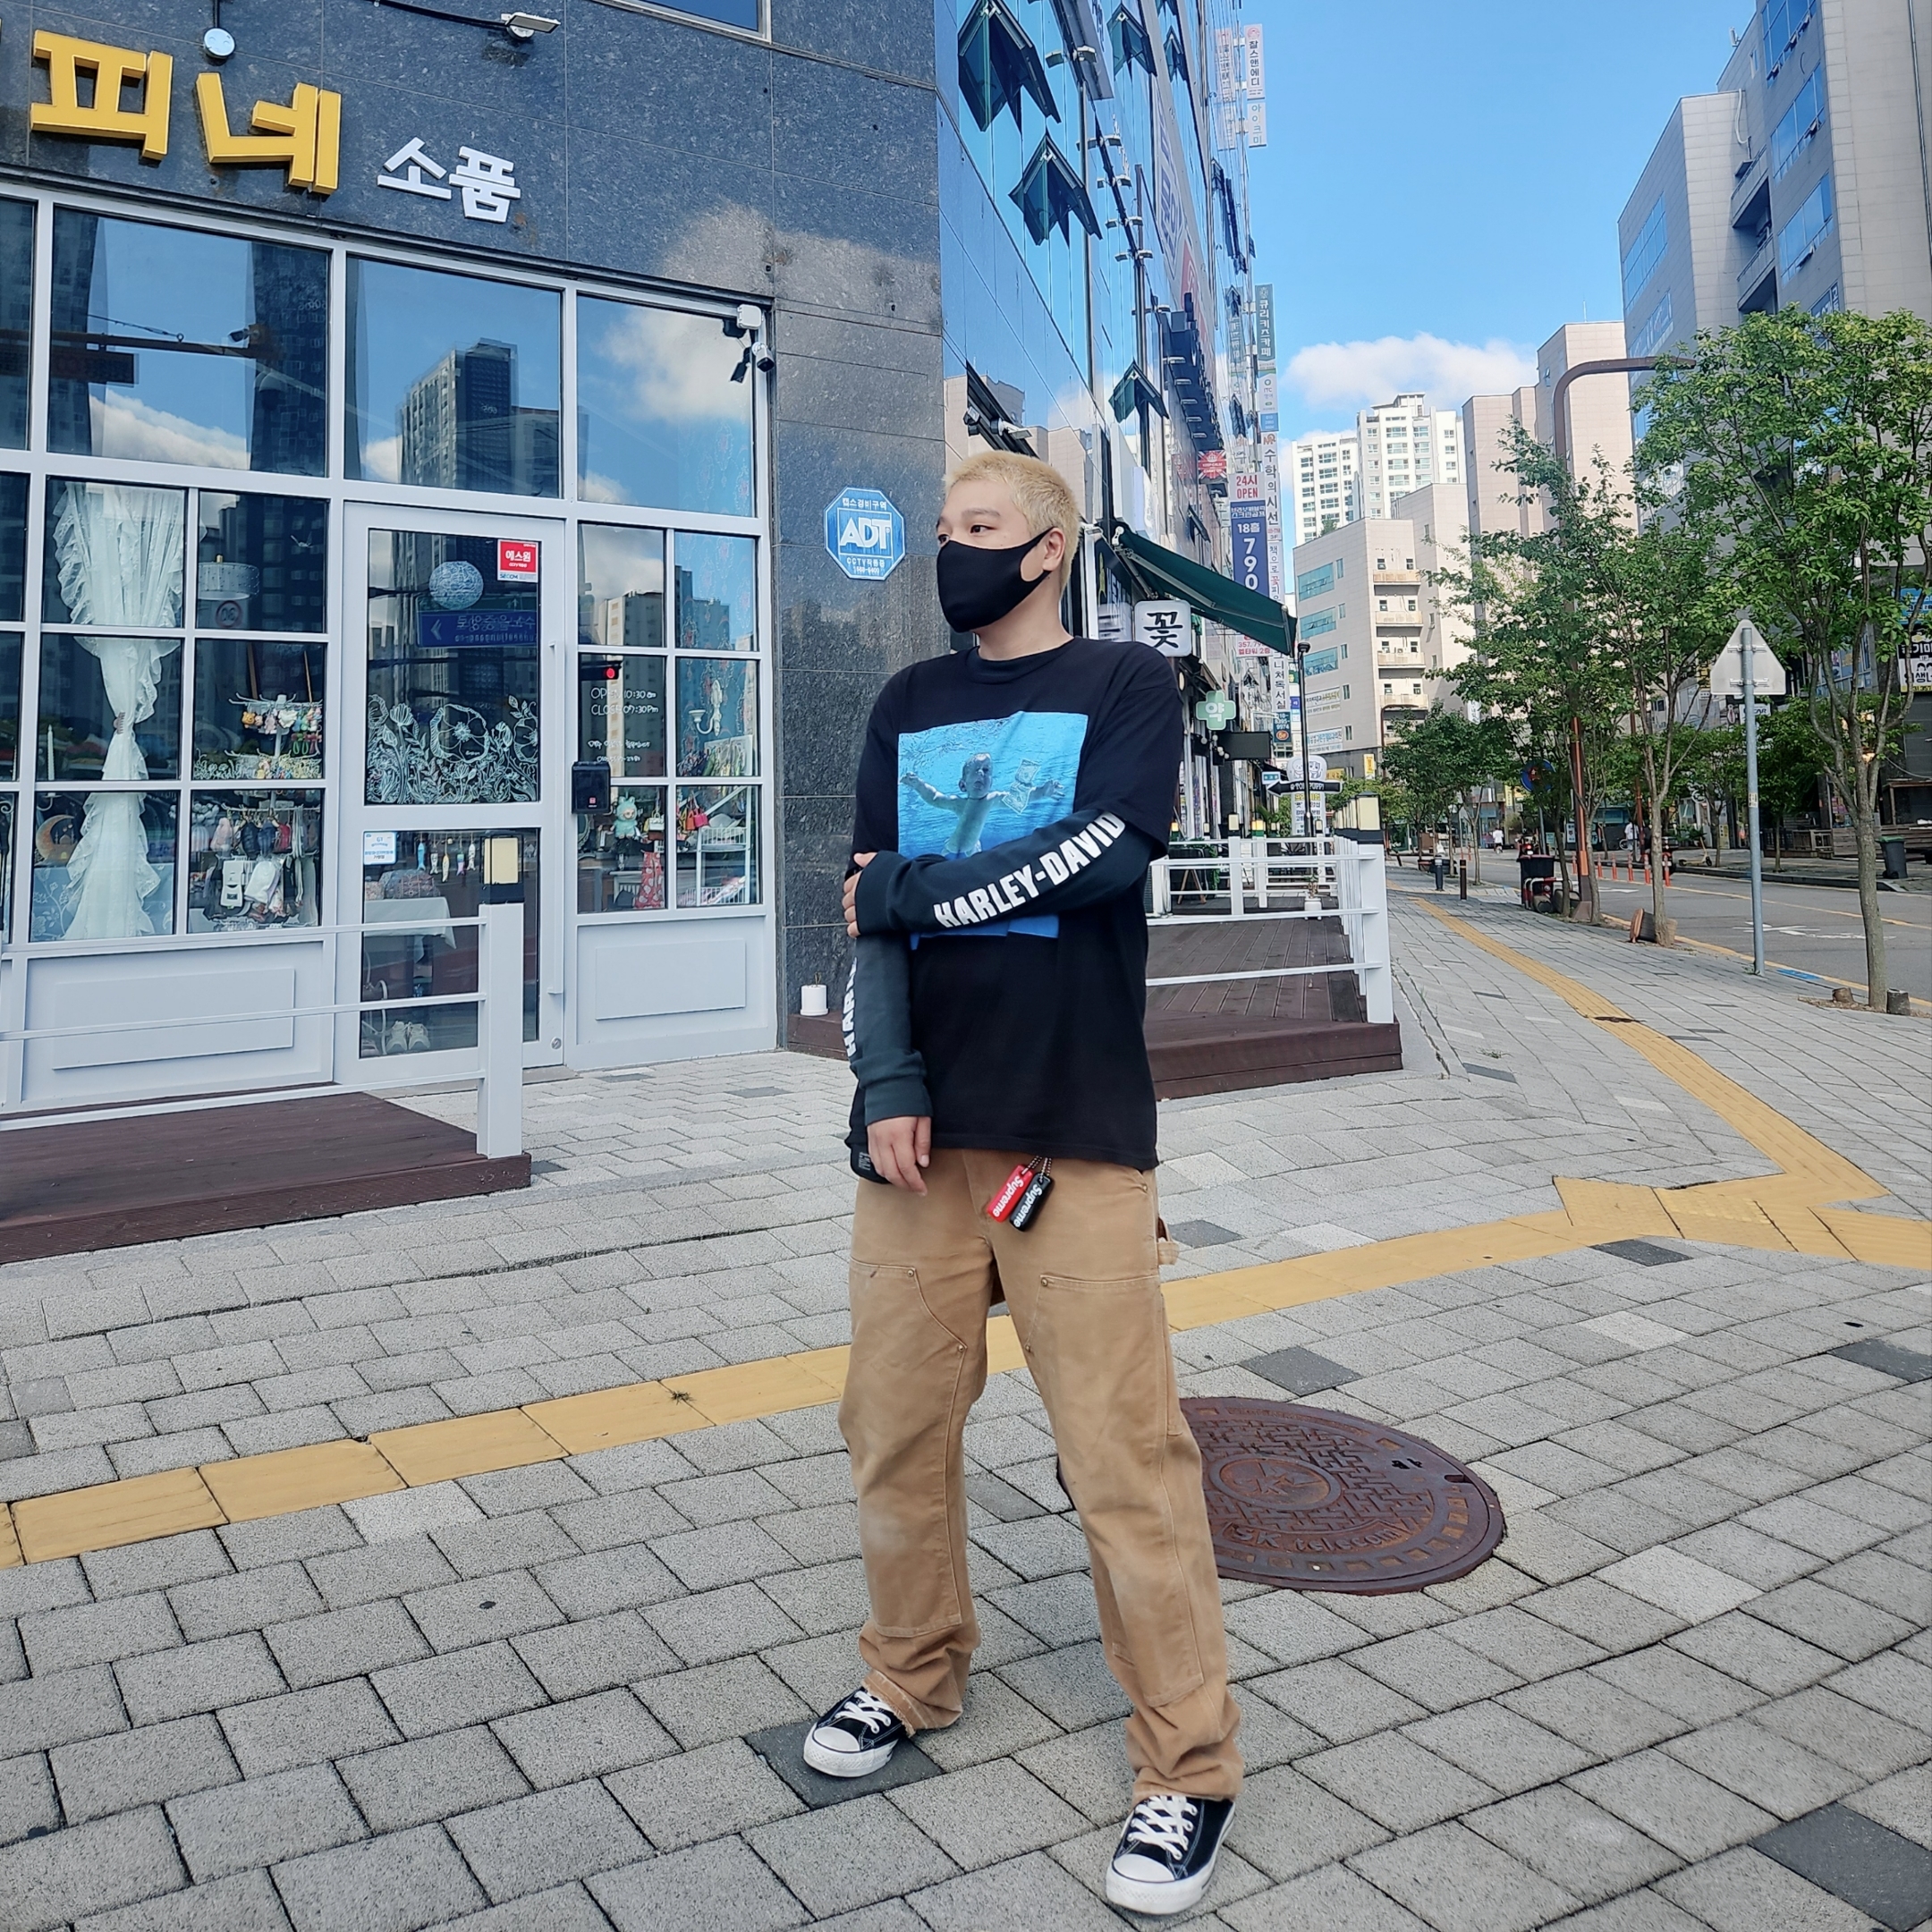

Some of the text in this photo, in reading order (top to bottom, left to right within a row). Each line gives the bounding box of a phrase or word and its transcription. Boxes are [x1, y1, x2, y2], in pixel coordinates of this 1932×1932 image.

[377, 137, 521, 224] 소품
[1258, 299, 1272, 357] 큐리키즈카페
[1236, 475, 1258, 487] 24시
[1236, 487, 1258, 499] OPEN
[1264, 448, 1279, 526] 수학의시선
[843, 497, 887, 511] 캡스경비구역
[839, 516, 891, 550] ADT
[1237, 522, 1260, 534] 18홀
[505, 550, 531, 563] 에스원
[1143, 611, 1183, 648] 꽃
[1205, 702, 1225, 722] 약
[933, 810, 1126, 928] HARLEY-DAVID
[992, 1174, 1025, 1218] Supreme
[1013, 1182, 1044, 1228] Supreme
[1232, 1525, 1403, 1552] SK telecom
